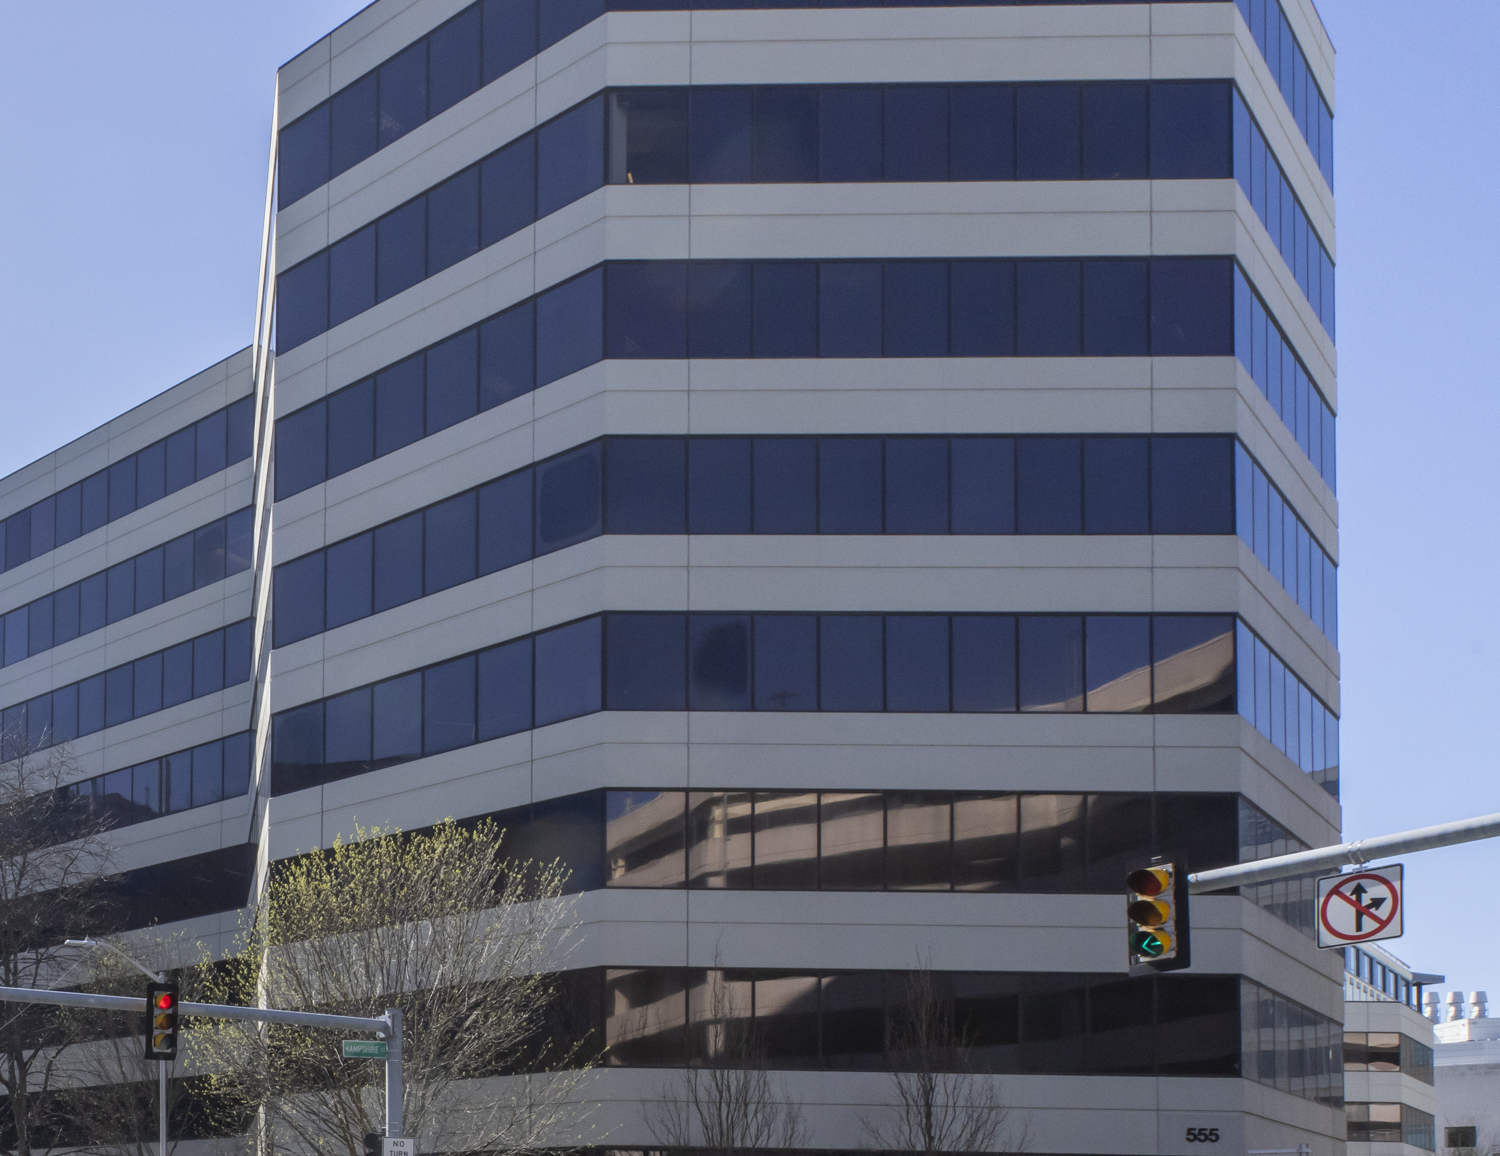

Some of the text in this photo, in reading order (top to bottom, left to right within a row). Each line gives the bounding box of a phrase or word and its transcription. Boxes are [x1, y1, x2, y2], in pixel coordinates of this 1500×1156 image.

[345, 1045, 380, 1054] HAMPSHIRE
[1185, 1127, 1220, 1143] 555
[392, 1140, 405, 1148] NO
